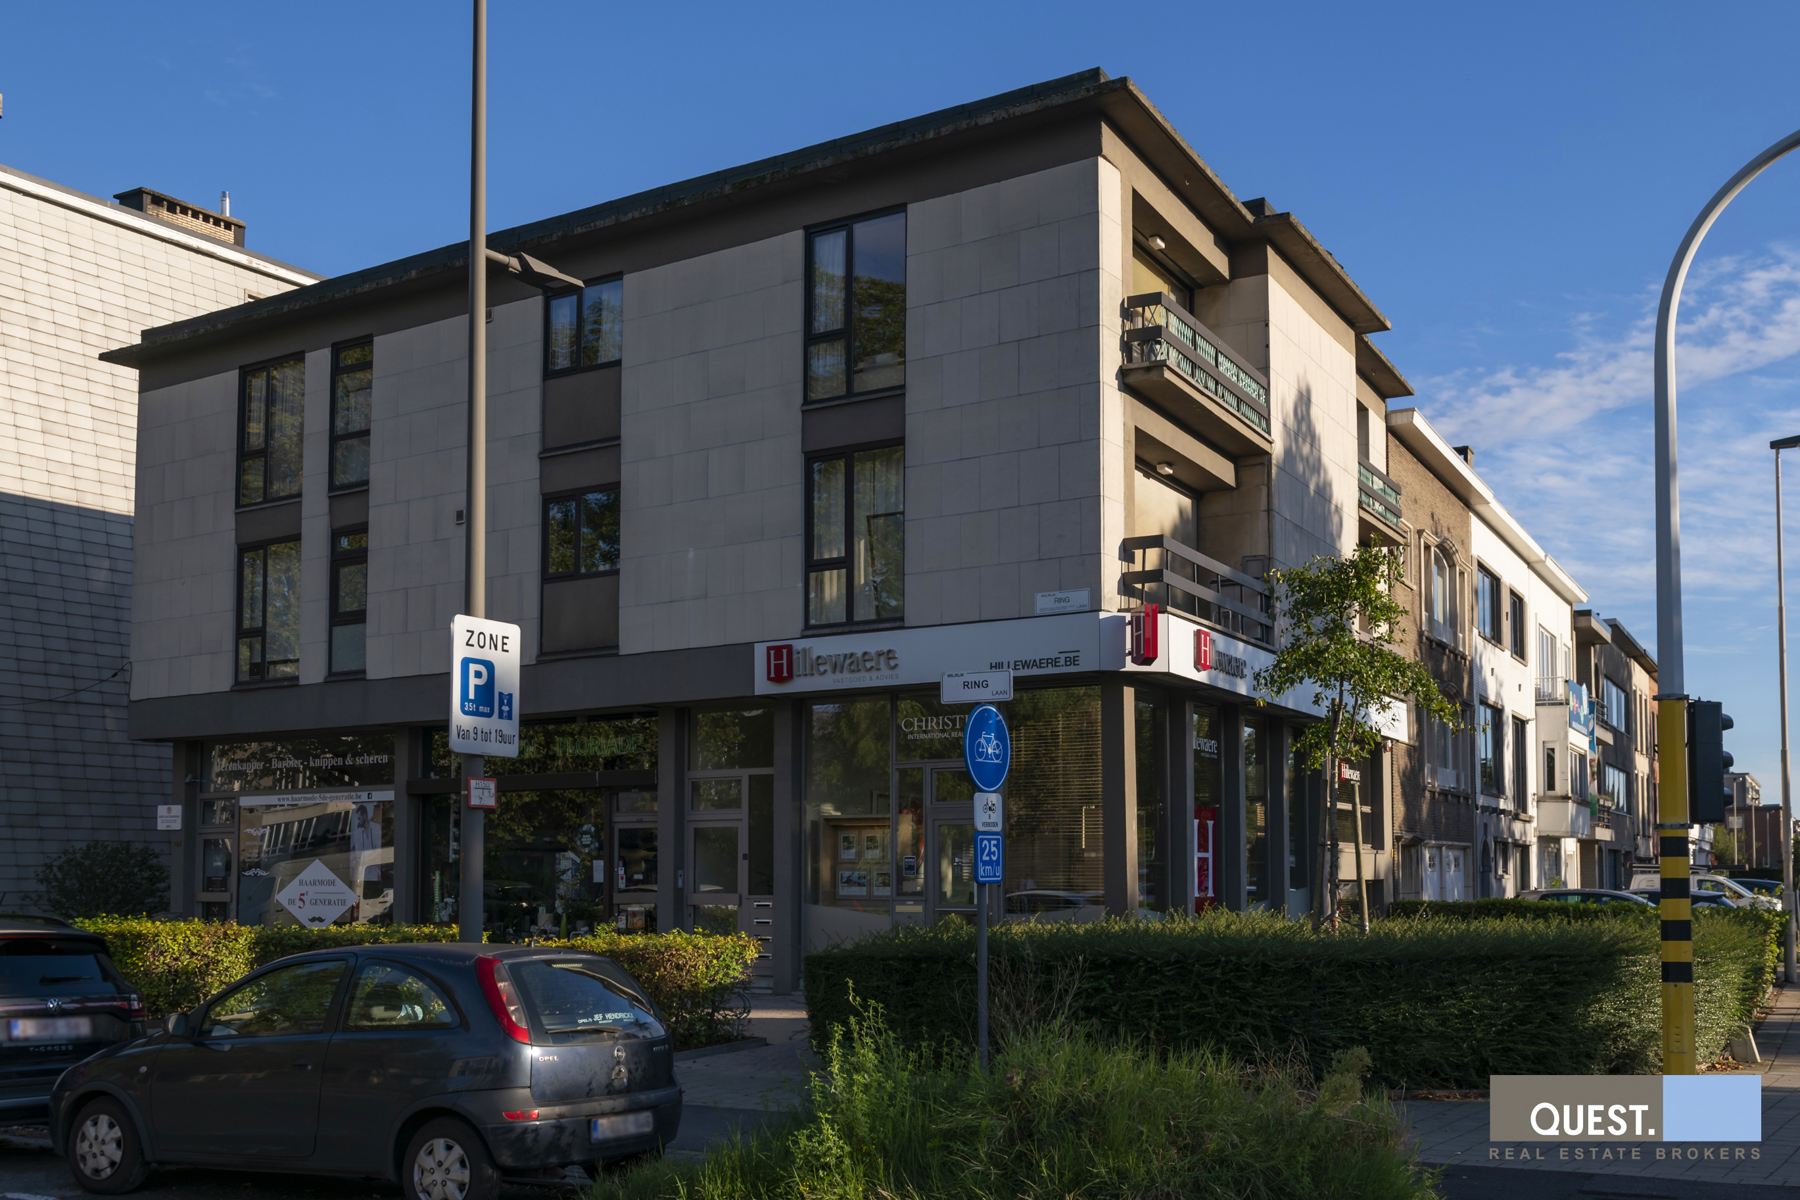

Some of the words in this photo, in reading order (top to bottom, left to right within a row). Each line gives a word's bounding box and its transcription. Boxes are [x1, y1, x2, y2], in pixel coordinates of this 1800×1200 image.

[1054, 596, 1070, 604] RING
[466, 629, 509, 653] ZONE
[769, 646, 899, 678] Hillewaere
[989, 655, 1080, 671] HILLEWAERE.BE
[468, 662, 488, 700] P
[963, 680, 989, 690] RING
[479, 705, 490, 713] max
[456, 725, 470, 740] Van
[473, 726, 478, 741] 9
[481, 727, 492, 743] tot
[495, 729, 516, 745] 19uur
[908, 732, 950, 740] INTERNATIONAL
[271, 757, 302, 769] Barbier
[310, 756, 342, 770] knippen
[345, 753, 353, 765] &
[355, 753, 388, 766] scheren
[982, 840, 998, 861] 25
[1194, 819, 1214, 897] H
[980, 862, 1000, 876] km/u
[298, 879, 337, 887] HAARMODE
[287, 898, 296, 906] DE
[309, 898, 347, 906] GENERATIE
